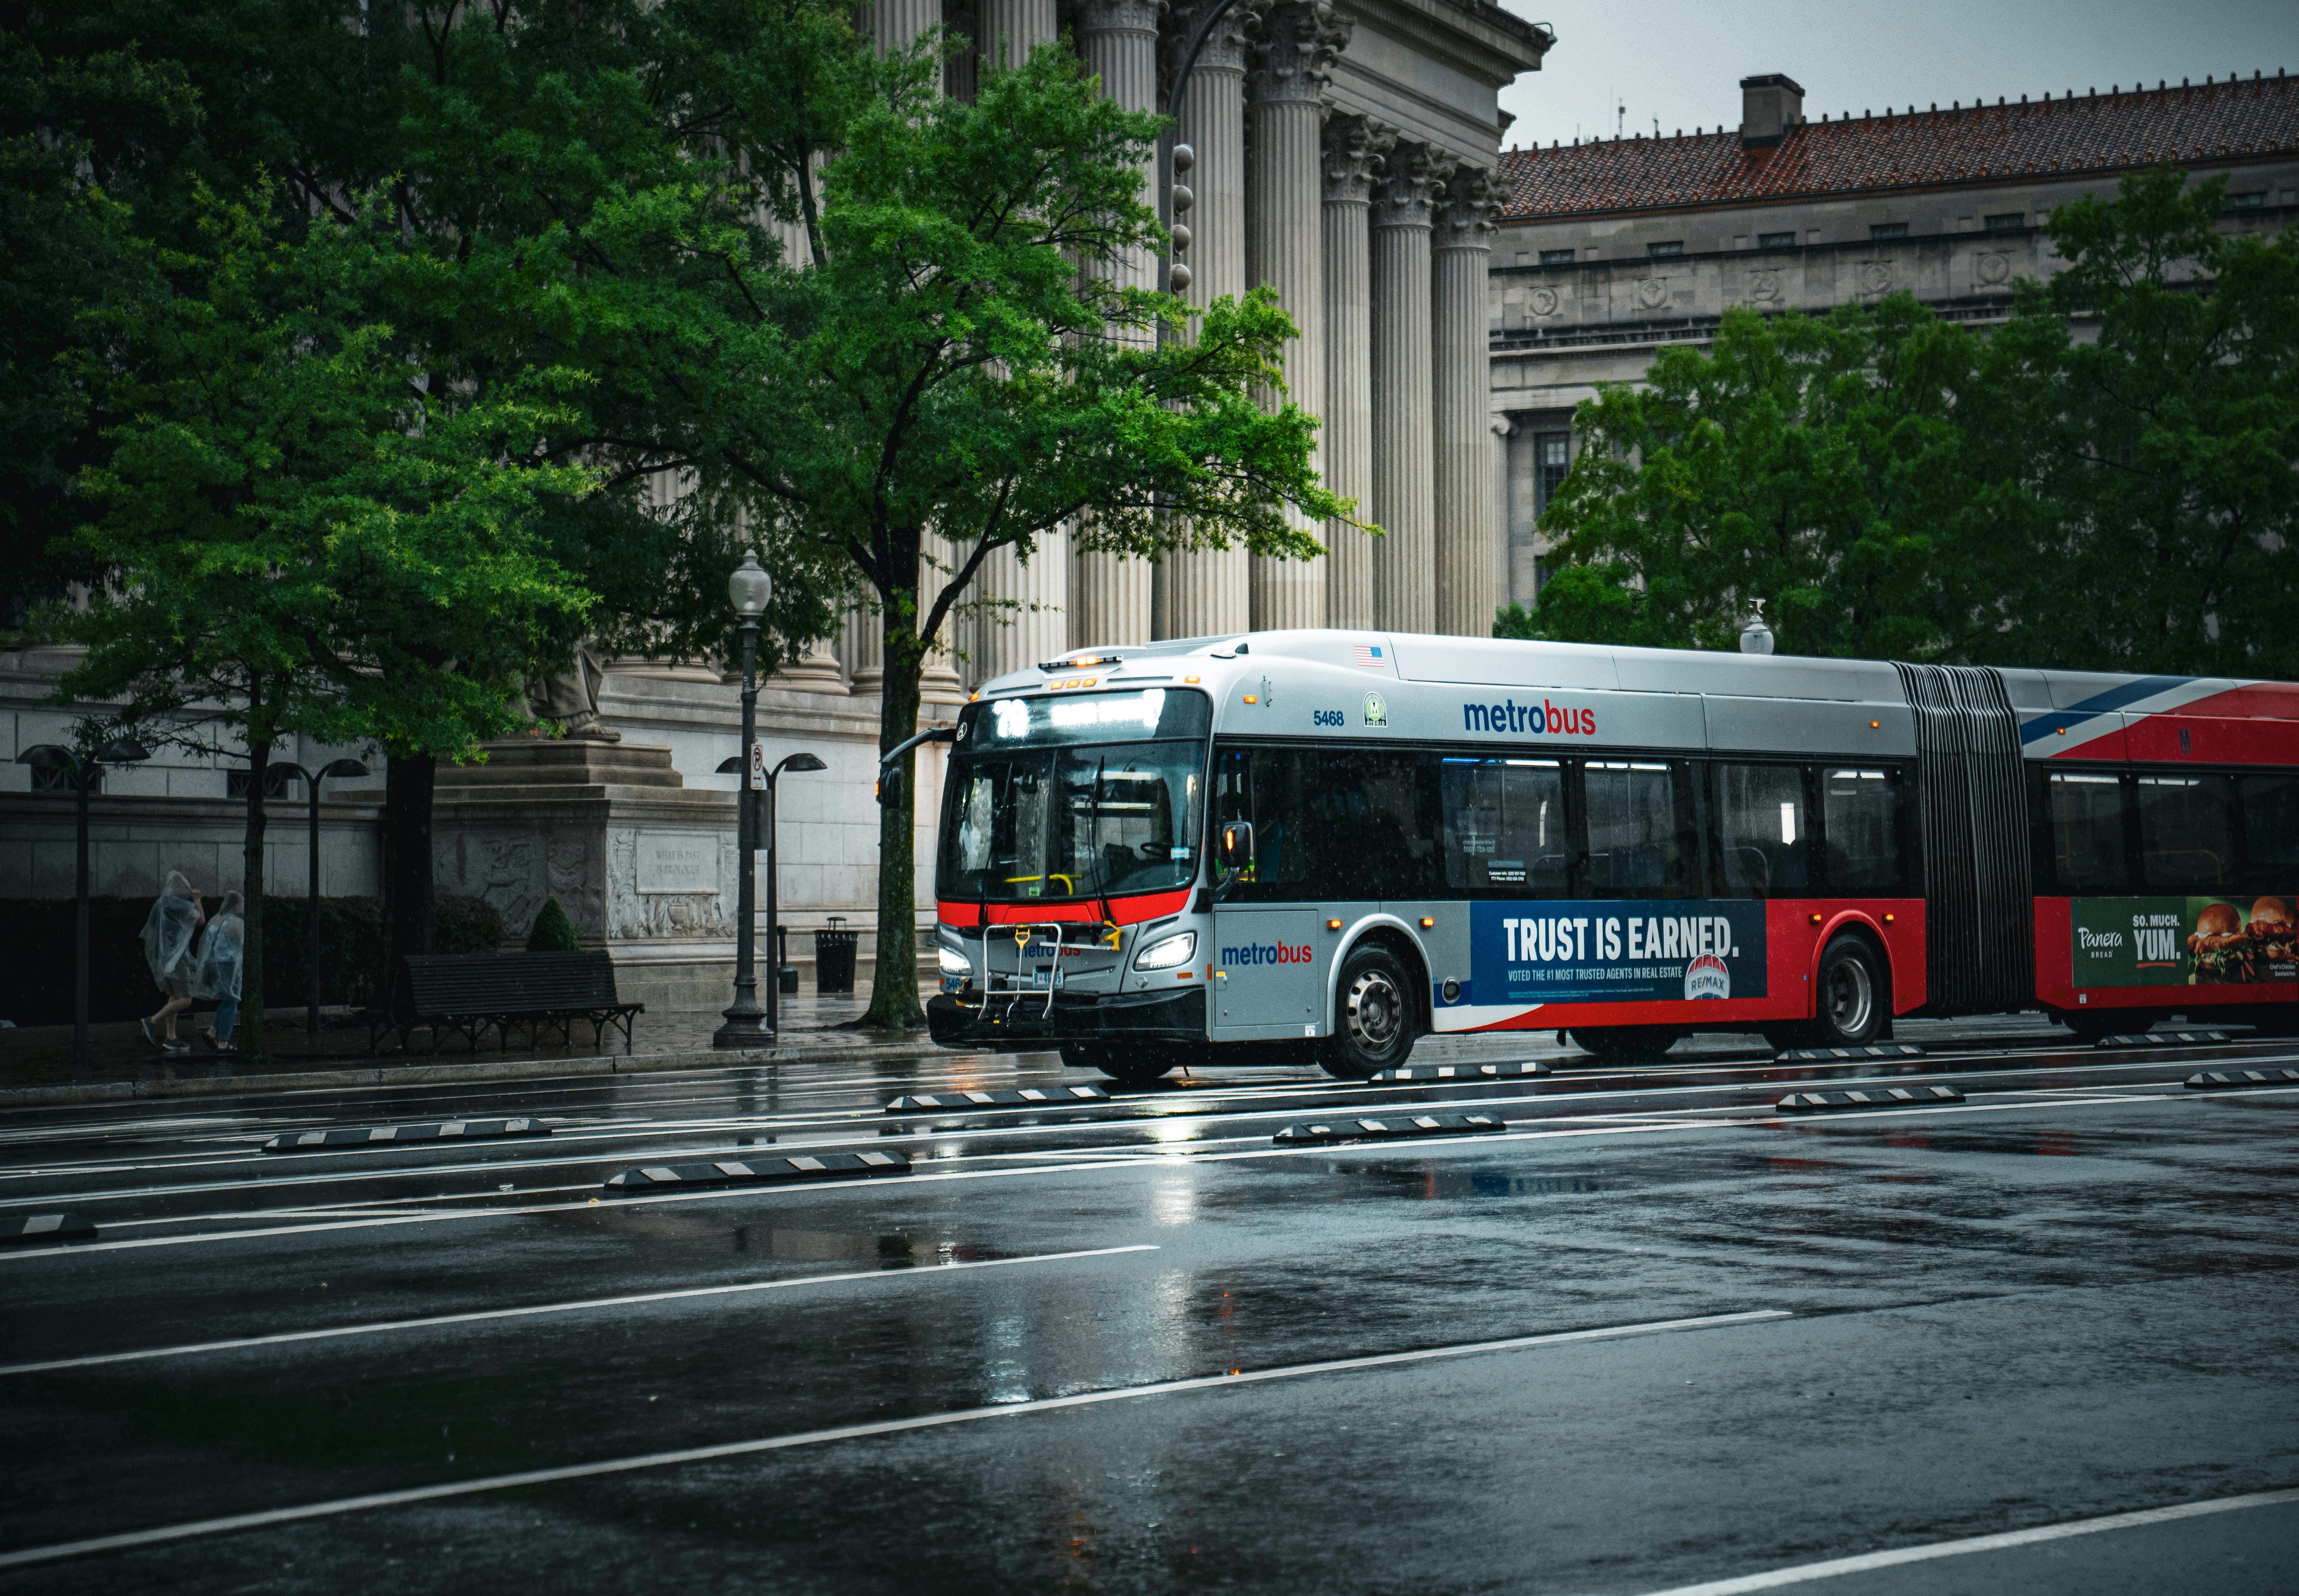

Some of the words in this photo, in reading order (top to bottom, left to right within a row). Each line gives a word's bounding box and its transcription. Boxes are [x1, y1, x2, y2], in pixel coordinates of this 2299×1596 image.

[1314, 711, 1344, 726] 5468
[1464, 699, 1596, 735] metrobus
[656, 850, 675, 860] WHAT
[2133, 915, 2148, 927] SO.
[2150, 915, 2180, 927] MUCH.
[1503, 918, 1588, 961] TRUST
[1596, 917, 1621, 960] IS
[1629, 917, 1739, 959] EARNED.
[2078, 927, 2122, 949] Panera
[2133, 929, 2181, 960] YUM.
[1222, 941, 1312, 965] metrobus
[1034, 973, 1037, 983] B
[1509, 970, 1530, 982] VOTED
[1532, 970, 1545, 981] THE
[1547, 970, 1553, 980] #1
[1555, 969, 1574, 980] MOST
[1576, 968, 1605, 980] TRUSTED
[1606, 968, 1632, 980] AGENTS
[1634, 968, 1640, 979] IN
[1642, 968, 1658, 978] REAL
[1660, 967, 1682, 978] ESTATE
[1691, 976, 1724, 992] RE/MAX
